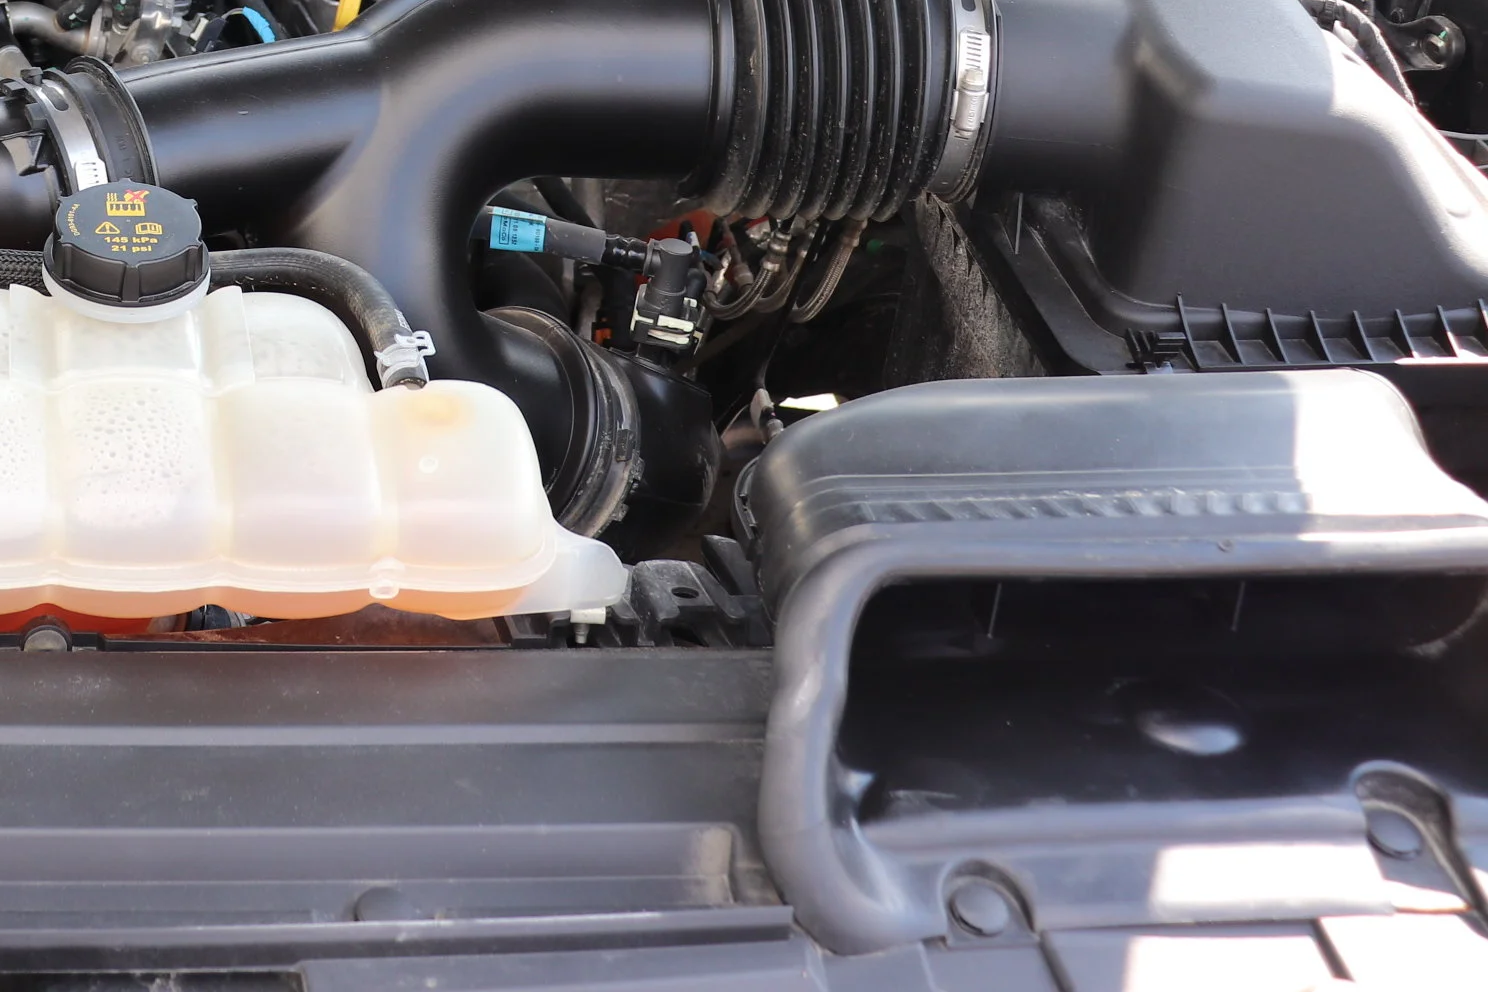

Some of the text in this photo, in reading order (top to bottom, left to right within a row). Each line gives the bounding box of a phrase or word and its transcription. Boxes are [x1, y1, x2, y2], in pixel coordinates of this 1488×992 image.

[104, 236, 158, 244] 145 kPa
[132, 245, 152, 253] psi
